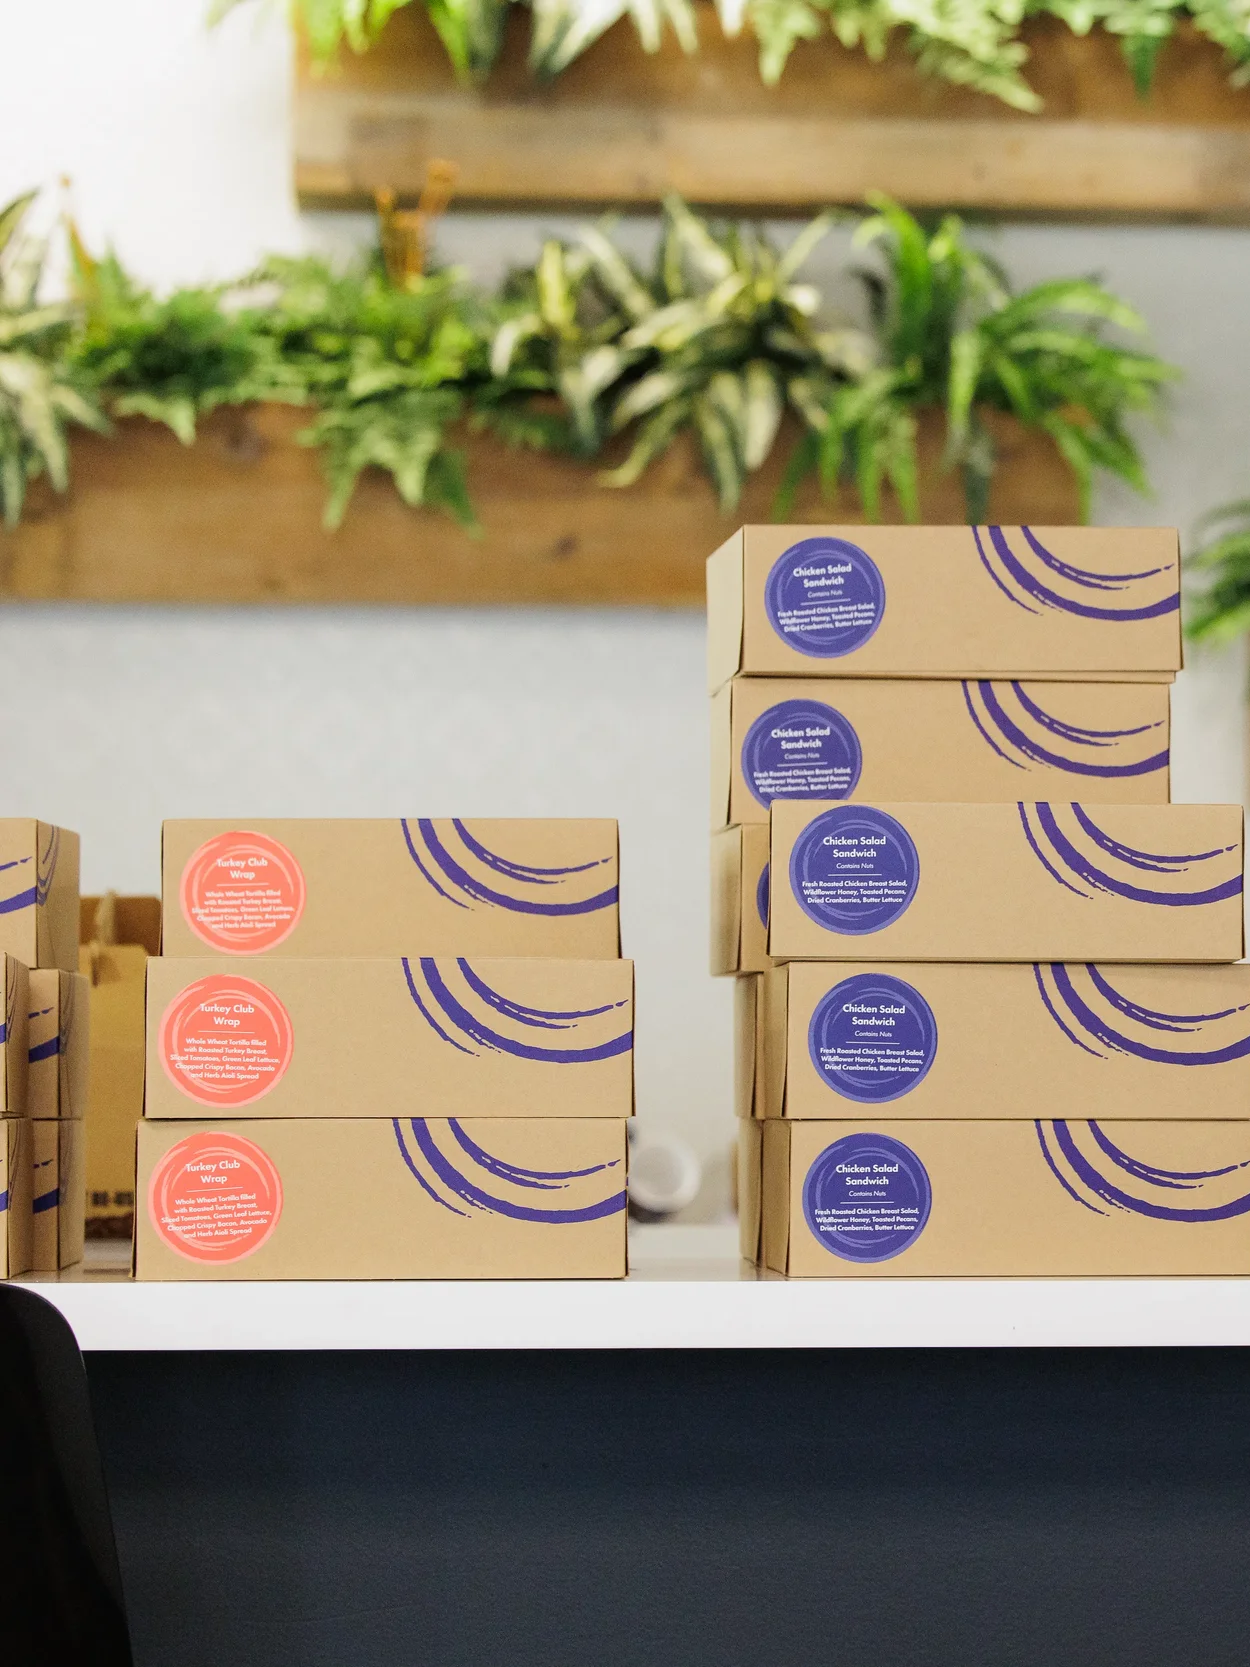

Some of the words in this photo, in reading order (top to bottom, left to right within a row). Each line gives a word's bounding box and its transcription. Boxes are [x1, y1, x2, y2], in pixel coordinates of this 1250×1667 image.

[793, 567, 825, 577] Chicken
[828, 563, 851, 573] Salad
[803, 576, 844, 588] Sandwich
[771, 729, 804, 738] Chicken
[806, 727, 830, 736] Salad
[781, 739, 821, 749] Sandwich
[823, 837, 858, 845] Chicken
[860, 836, 886, 845] Salad
[833, 849, 876, 857] Sandwich
[216, 858, 245, 868] Turkey
[248, 858, 267, 866] Club
[230, 871, 255, 880] Wrap
[200, 1004, 231, 1015] Turkey
[234, 1005, 254, 1013] Club
[842, 1004, 877, 1013] Chicken
[880, 1005, 905, 1014] Salad
[214, 1017, 240, 1027] Wrap
[852, 1017, 895, 1026] Sandwich
[185, 1163, 216, 1172] Turkey
[219, 1160, 240, 1169] Club
[836, 1164, 870, 1173] Chicken
[873, 1164, 898, 1173] Salad
[201, 1175, 227, 1184] Wrap
[846, 1177, 889, 1185] Sandwich
